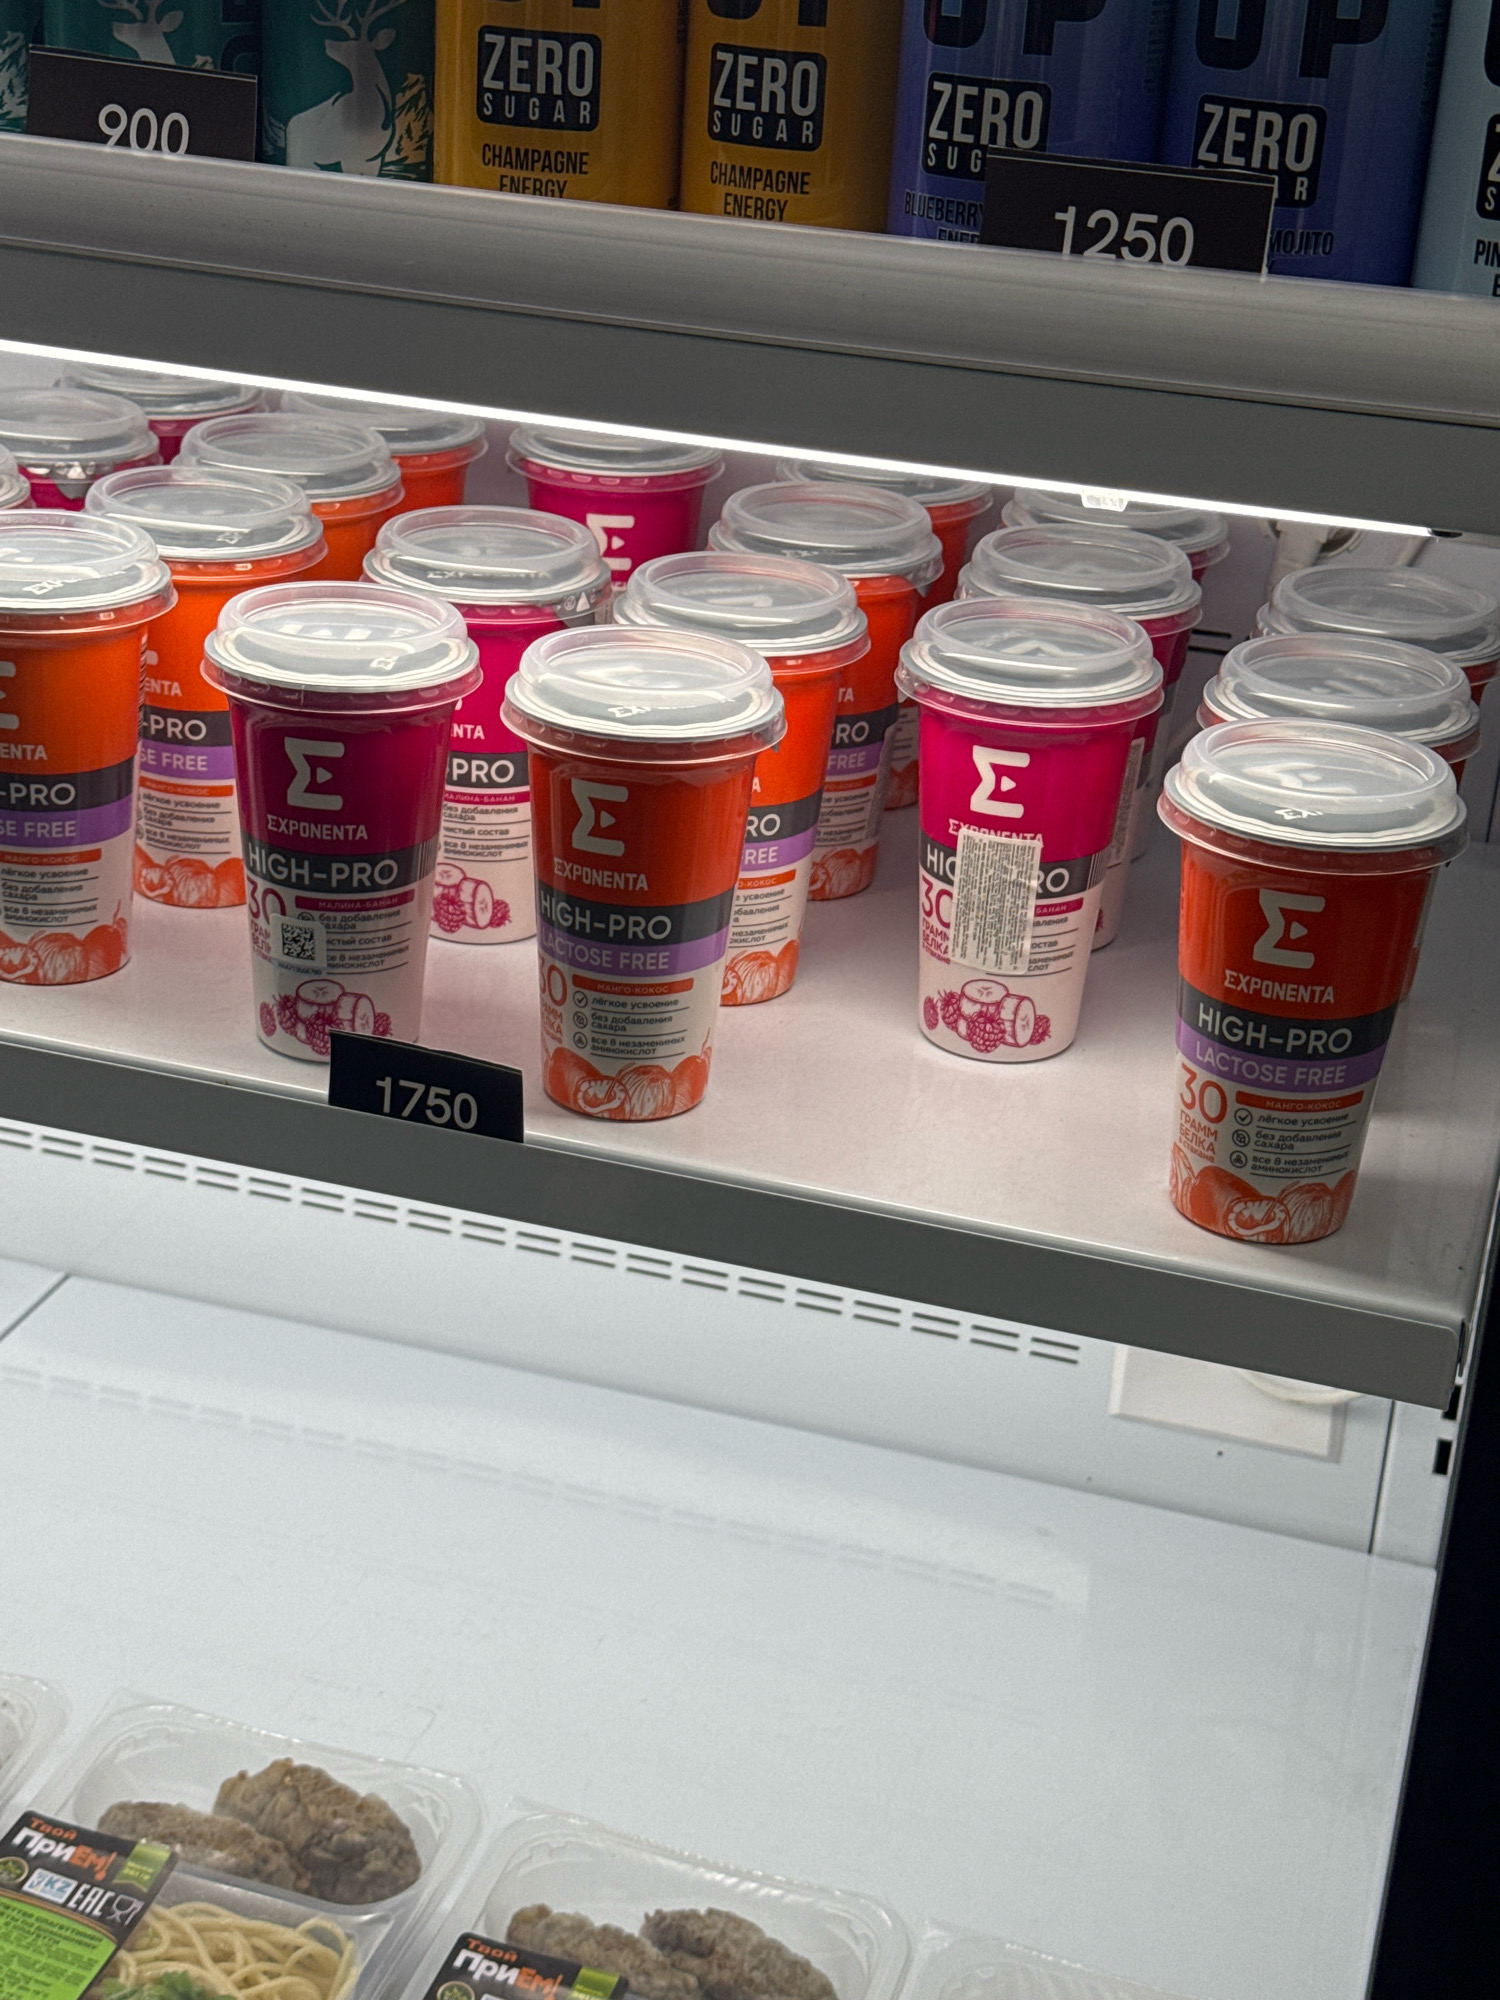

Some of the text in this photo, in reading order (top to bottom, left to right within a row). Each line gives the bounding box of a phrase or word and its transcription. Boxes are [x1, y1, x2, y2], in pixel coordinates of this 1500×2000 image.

[482, 33, 595, 97] ZERO
[713, 51, 820, 117] ZERO
[482, 92, 591, 126] SUGAR
[928, 80, 1044, 149] ZERO
[98, 103, 190, 154] 900
[712, 109, 814, 144] SUGAR
[1197, 103, 1317, 172] ZERO
[481, 143, 590, 175] CHAMPAGNE
[926, 142, 982, 173] SUG
[710, 161, 811, 195] CHAMPAGNE
[723, 192, 788, 222] ENERGY
[1054, 205, 1195, 267] 1250
[161, 751, 209, 772] FREE
[827, 751, 867, 771] FREE
[24, 819, 77, 838] FREE
[248, 842, 399, 888] HIGH-PRO
[743, 845, 779, 866] REE
[540, 890, 672, 940] HIGH-PRO
[541, 927, 670, 971] LACTOSE FREE
[1031, 940, 1058, 949] остав
[597, 983, 669, 995] МАНГО-КОКОС
[630, 998, 680, 1010] усвоение
[1197, 1002, 1353, 1054] HIGH-PRO
[1195, 1040, 1347, 1086] LACTOSE FREE
[375, 1076, 478, 1130] 1750
[1180, 1062, 1228, 1124] 30
[1265, 1099, 1342, 1111] МАНГО-КОКОС
[1180, 1108, 1218, 1141] ГРАММ
[1255, 1130, 1342, 1143] без добавления
[1258, 1113, 1349, 1128] лёгкое усвоение
[1179, 1123, 1216, 1155] БЕЛКА
[1254, 1140, 1295, 1151] сахара
